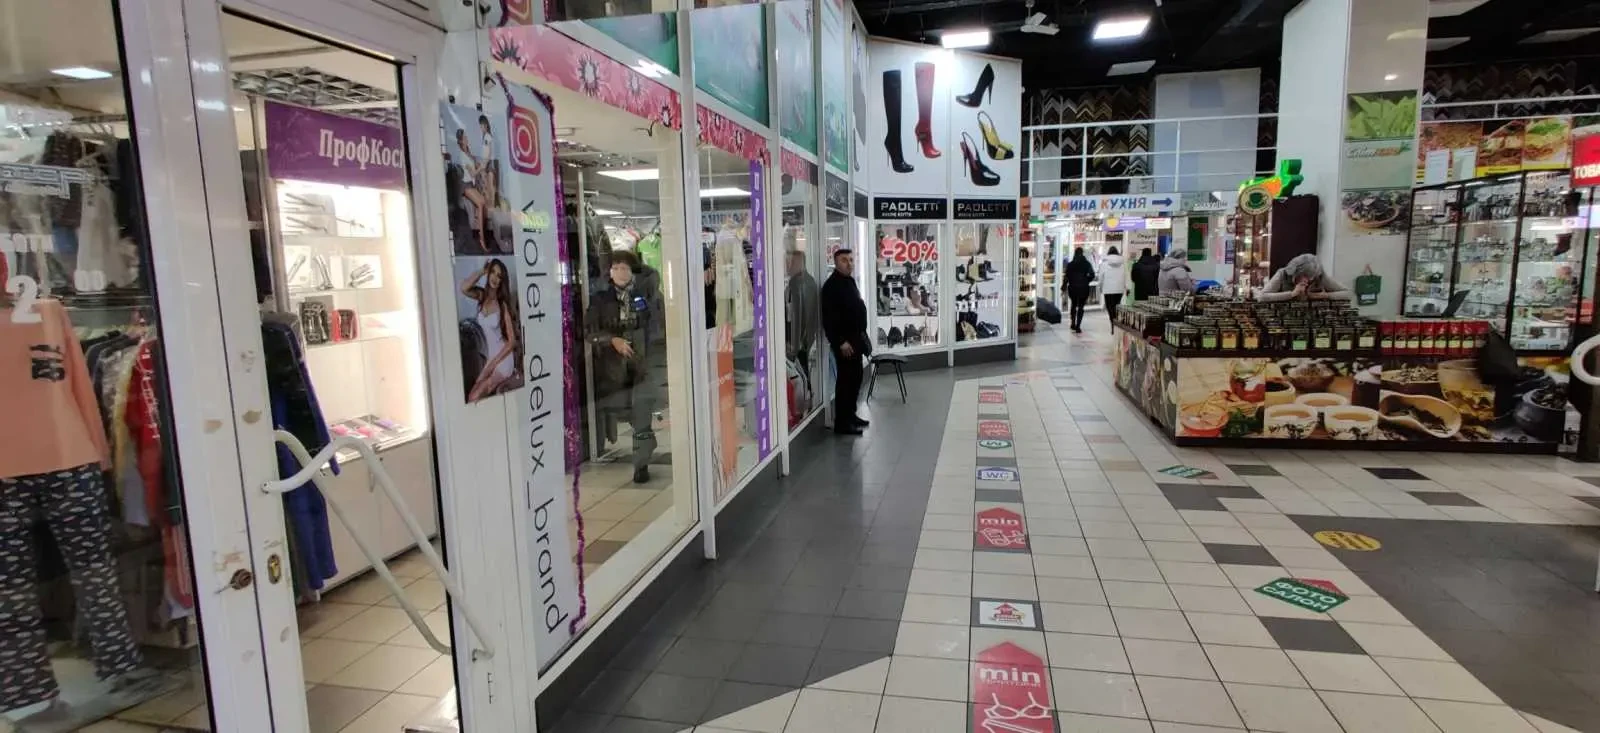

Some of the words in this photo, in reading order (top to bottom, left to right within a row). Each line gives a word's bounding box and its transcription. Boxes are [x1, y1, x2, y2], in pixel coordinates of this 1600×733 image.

[318, 128, 402, 170] ПрофКос
[881, 202, 939, 212] PAOLETTI
[1040, 199, 1096, 213] МАМИНА
[1101, 197, 1147, 210] КУХНЯ
[882, 240, 939, 264] -20%
[980, 517, 1019, 526] min
[1263, 586, 1329, 611] САЛОН
[1275, 581, 1337, 604] ФОТО
[979, 667, 1041, 684] min
